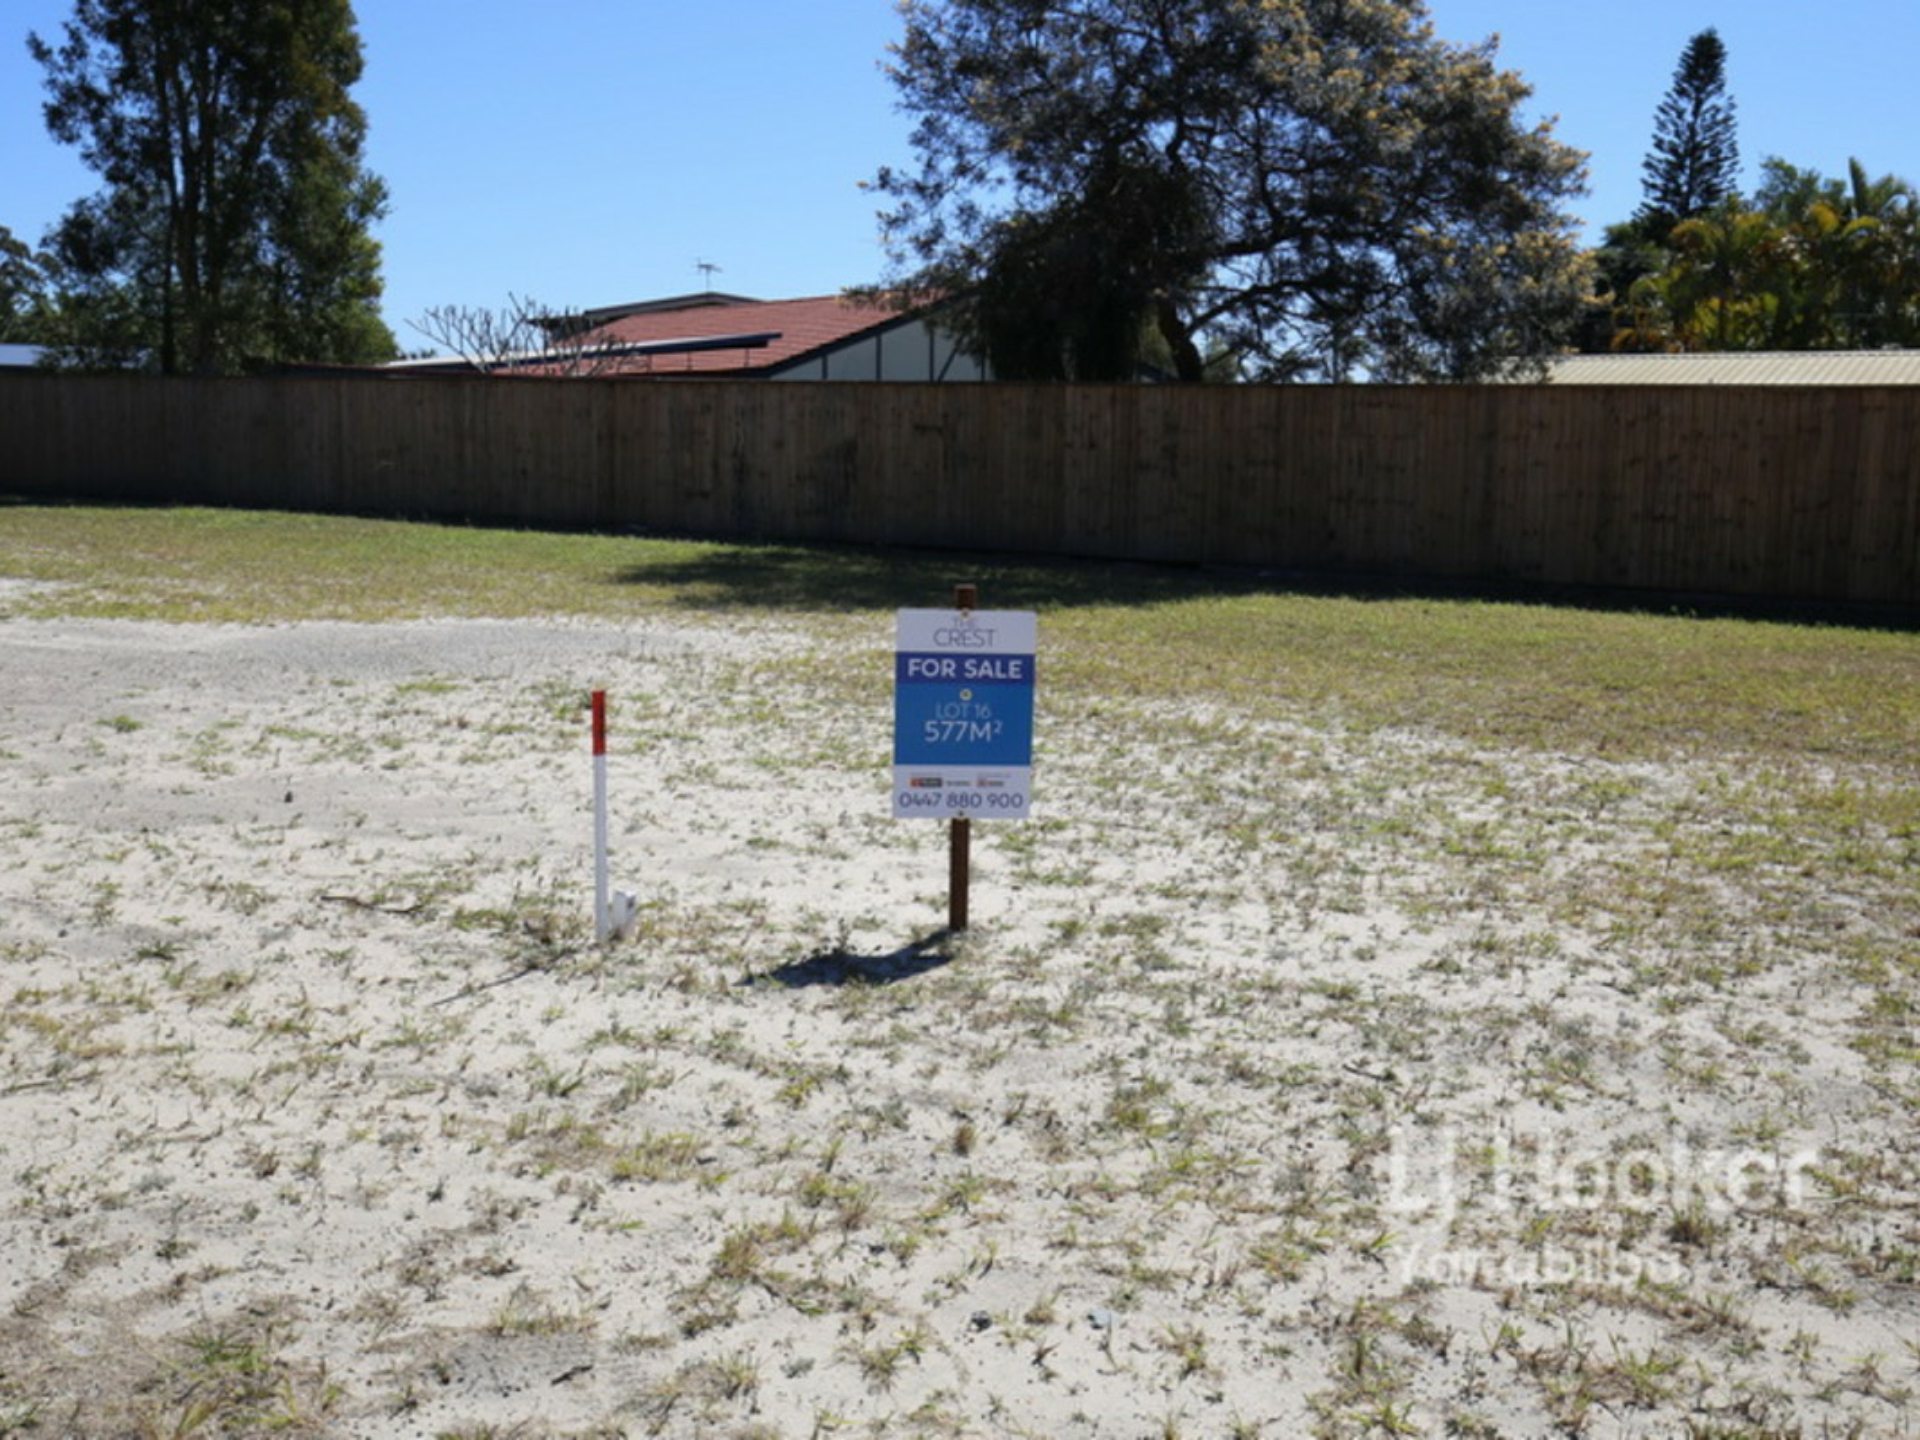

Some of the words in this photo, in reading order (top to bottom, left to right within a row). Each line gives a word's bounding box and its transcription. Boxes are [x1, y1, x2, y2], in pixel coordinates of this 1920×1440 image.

[932, 628, 995, 648] CREST
[907, 658, 956, 678] FOR
[964, 659, 1022, 679] SALE
[935, 702, 970, 719] LOT
[974, 704, 991, 719] 16
[899, 791, 943, 808] 0447
[946, 791, 982, 808] 880
[986, 792, 1023, 808] 900
